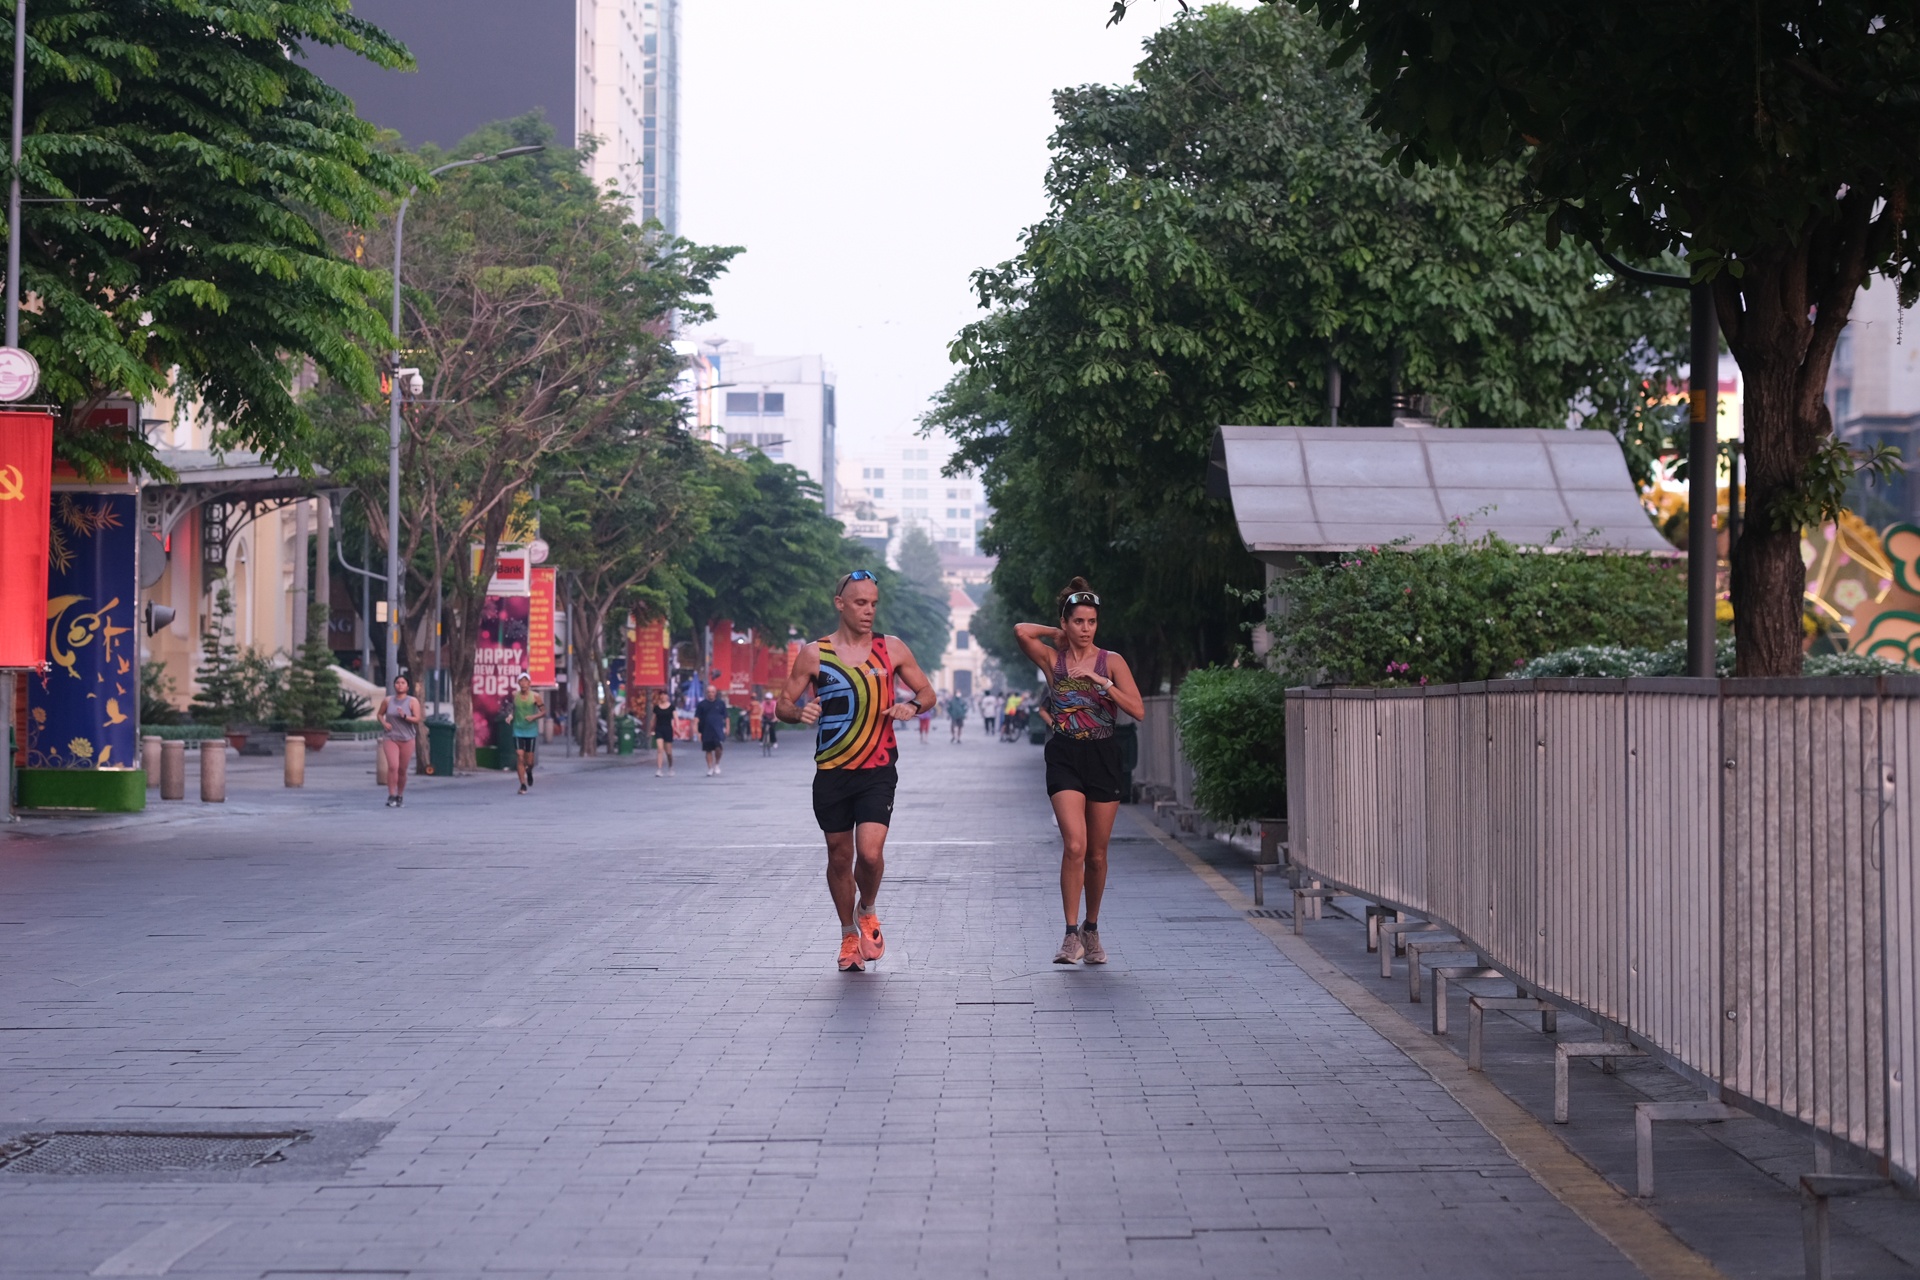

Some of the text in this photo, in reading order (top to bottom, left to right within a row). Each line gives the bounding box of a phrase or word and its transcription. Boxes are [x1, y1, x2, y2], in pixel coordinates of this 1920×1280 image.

[496, 564, 522, 574] Bank
[474, 648, 523, 664] HAPPY
[497, 664, 522, 676] YEAR
